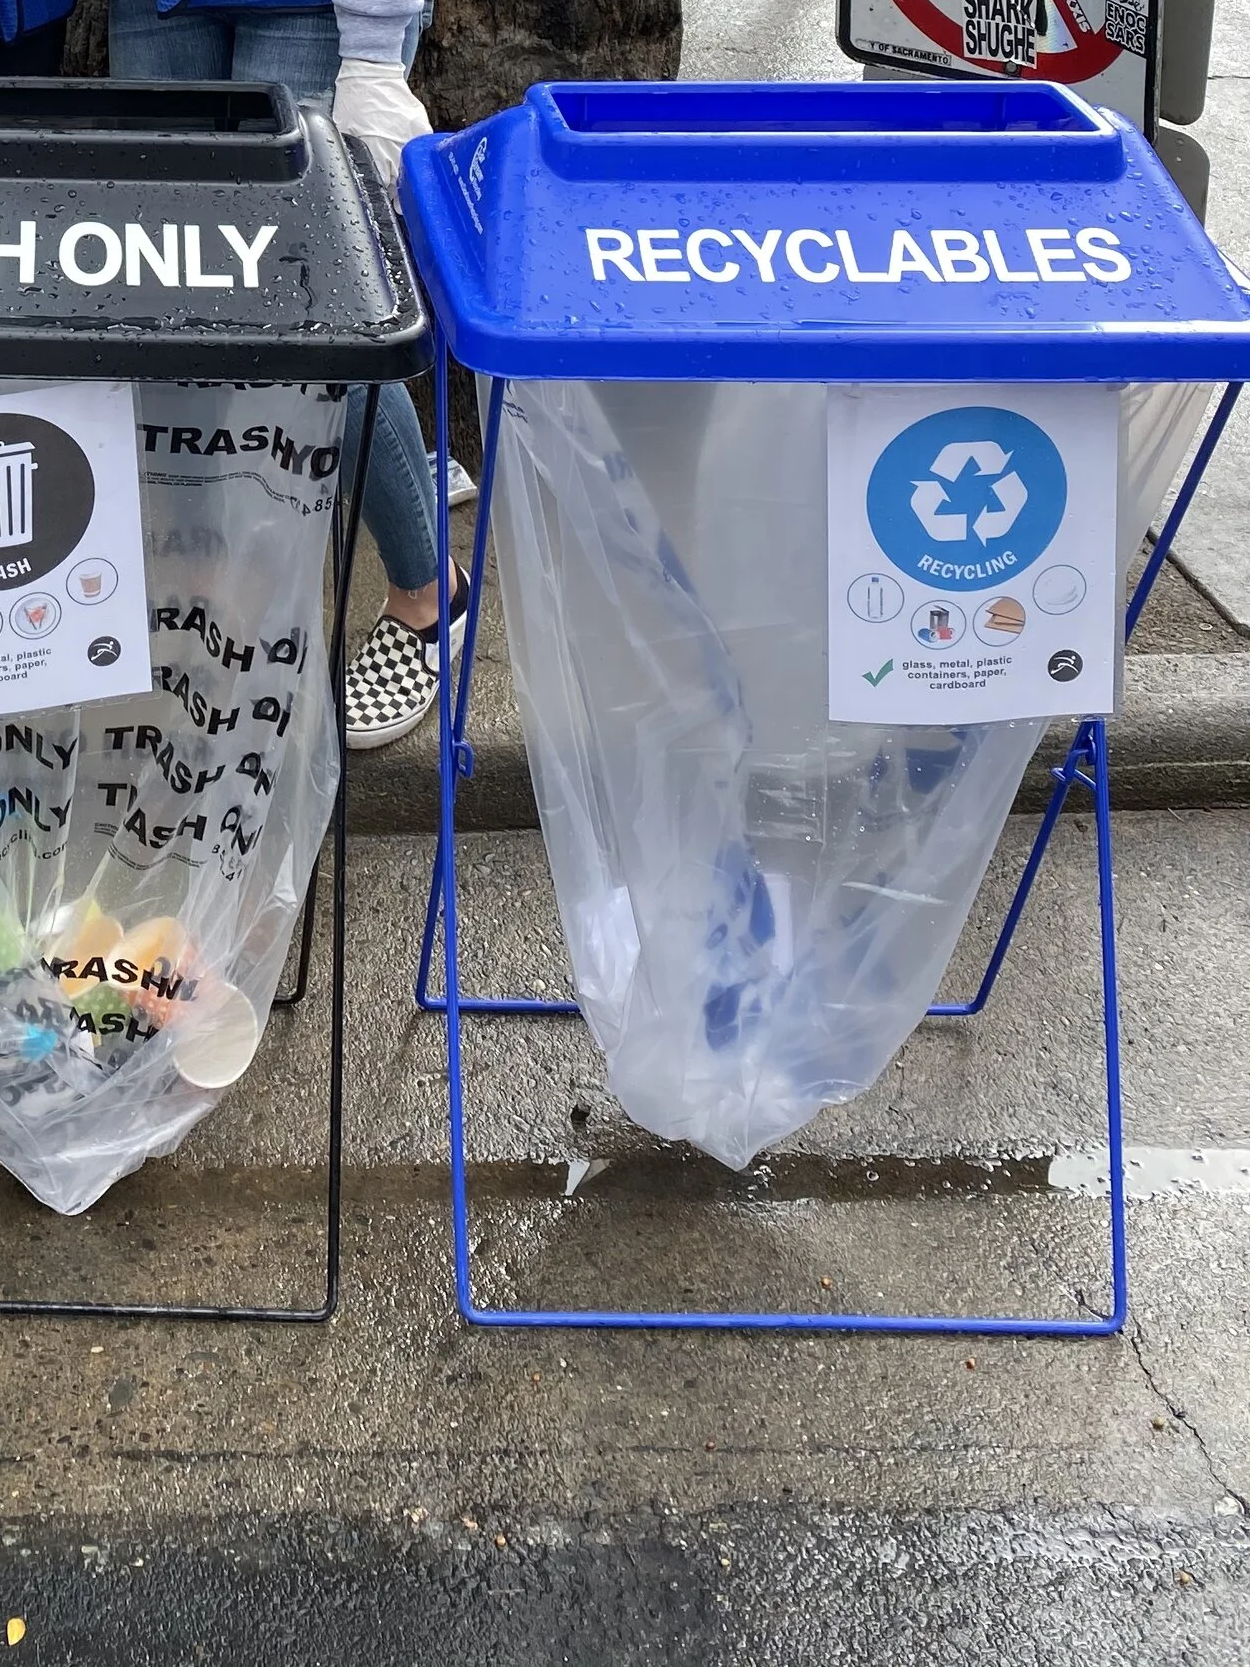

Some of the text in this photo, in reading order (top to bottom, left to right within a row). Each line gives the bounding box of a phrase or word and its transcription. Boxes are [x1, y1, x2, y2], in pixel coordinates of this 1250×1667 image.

[1106, 21, 1145, 54] SARS
[892, 45, 949, 66] SACRAMENTO
[58, 221, 280, 288] ONLY
[585, 228, 1133, 283] RECYCLABLES
[917, 550, 1018, 580] RECYCLING
[16, 648, 52, 661] plastic
[156, 606, 255, 672] RASH
[15, 659, 47, 671] paper,
[902, 656, 1012, 671] glass, metal, plastic
[907, 667, 1007, 680] containers, paper,
[161, 666, 240, 735] RASH
[929, 680, 987, 690] cardboard
[104, 725, 227, 795] TRASH
[98, 782, 208, 850] TASH
